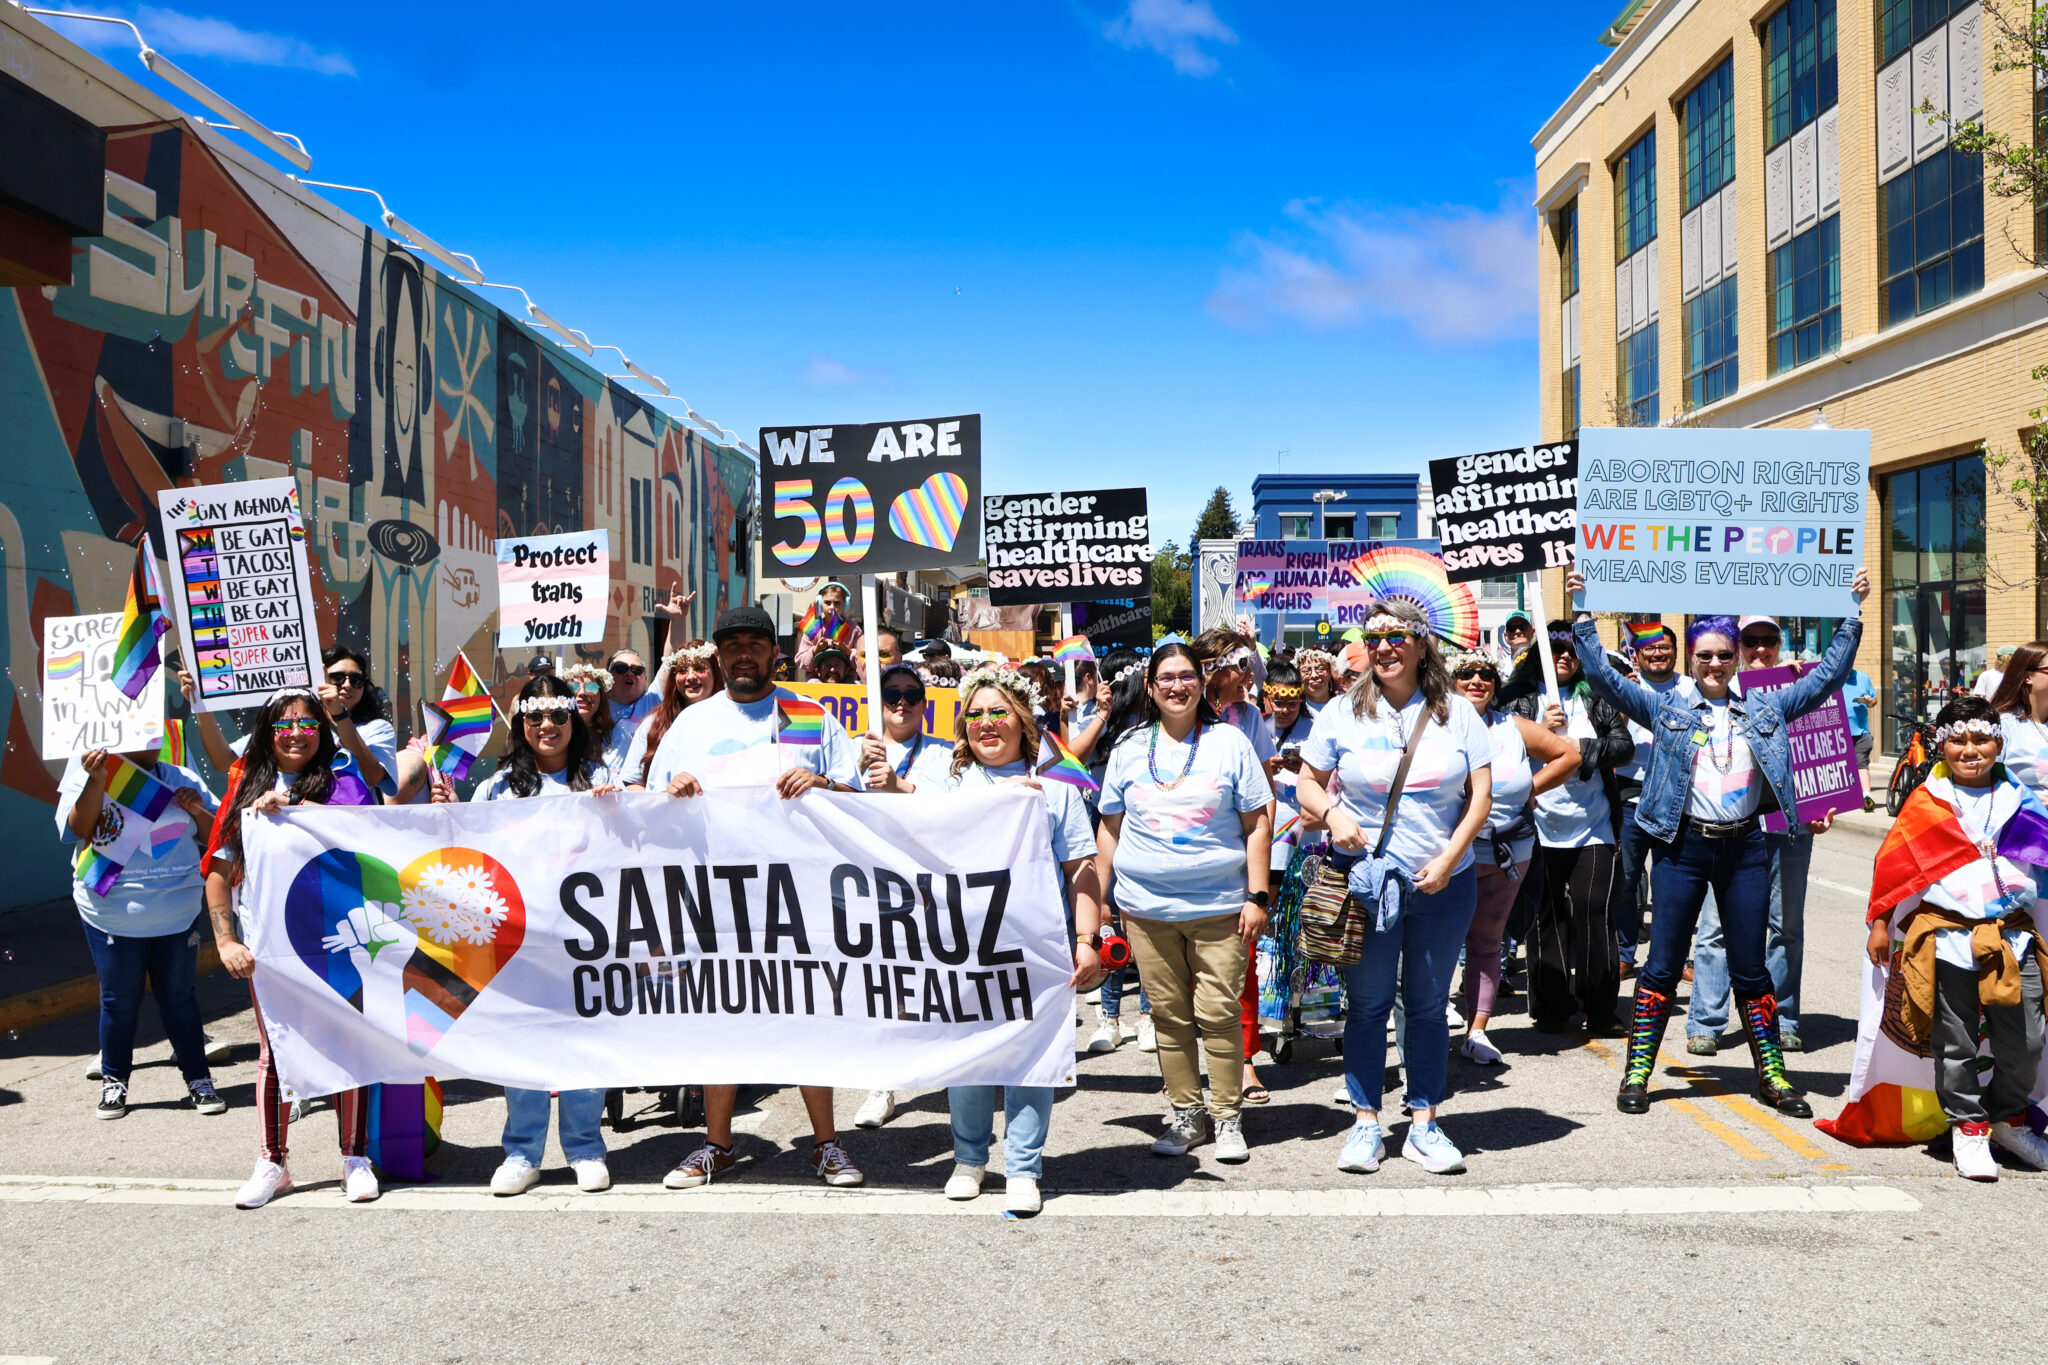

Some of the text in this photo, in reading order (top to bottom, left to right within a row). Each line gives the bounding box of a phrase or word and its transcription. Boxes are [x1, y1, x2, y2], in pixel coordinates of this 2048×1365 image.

[764, 420, 962, 466] WE ARE
[1456, 444, 1572, 484] gender
[1585, 458, 1860, 485] ABORTION RIGHTS
[985, 492, 1097, 520] gender
[1435, 473, 1578, 515] affirmin
[1584, 488, 1859, 516] ARE LGBTQ+ RIGHTS
[165, 496, 293, 521] THE GAY AGENDA
[771, 476, 875, 566] 50
[196, 527, 284, 553] M BE GAY
[986, 515, 1148, 543] affirming
[1437, 507, 1577, 546] healthca
[1581, 524, 1854, 555] WE THE PEOPLE
[201, 551, 291, 577] T TACOS!
[513, 541, 597, 568] Protect
[987, 540, 1156, 568] healthcare
[1238, 541, 1328, 569] TRANS RIGHT
[1443, 542, 1525, 571] saves
[1581, 558, 1854, 588] MEANS EVERYONE
[203, 577, 289, 601] W BE GAY
[531, 580, 583, 604] trans
[1261, 592, 1313, 610] RIGHTS
[200, 600, 289, 625] TH BE GAY
[212, 622, 300, 646] F SUPER GAY
[524, 614, 583, 643] youth
[213, 645, 301, 669] S SUPER GAY
[217, 674, 229, 690] S
[235, 670, 286, 691] MARCH
[51, 697, 80, 725] in
[1810, 708, 1842, 729] PRIVILEGE
[72, 720, 122, 751] ALLY
[1806, 730, 1836, 761] CARE
[1835, 727, 1848, 755] IS
[1793, 767, 1817, 799] MAN
[559, 863, 1024, 967] SANTA CRUZ
[573, 958, 1034, 1024] COMMUNITY HEALTH
